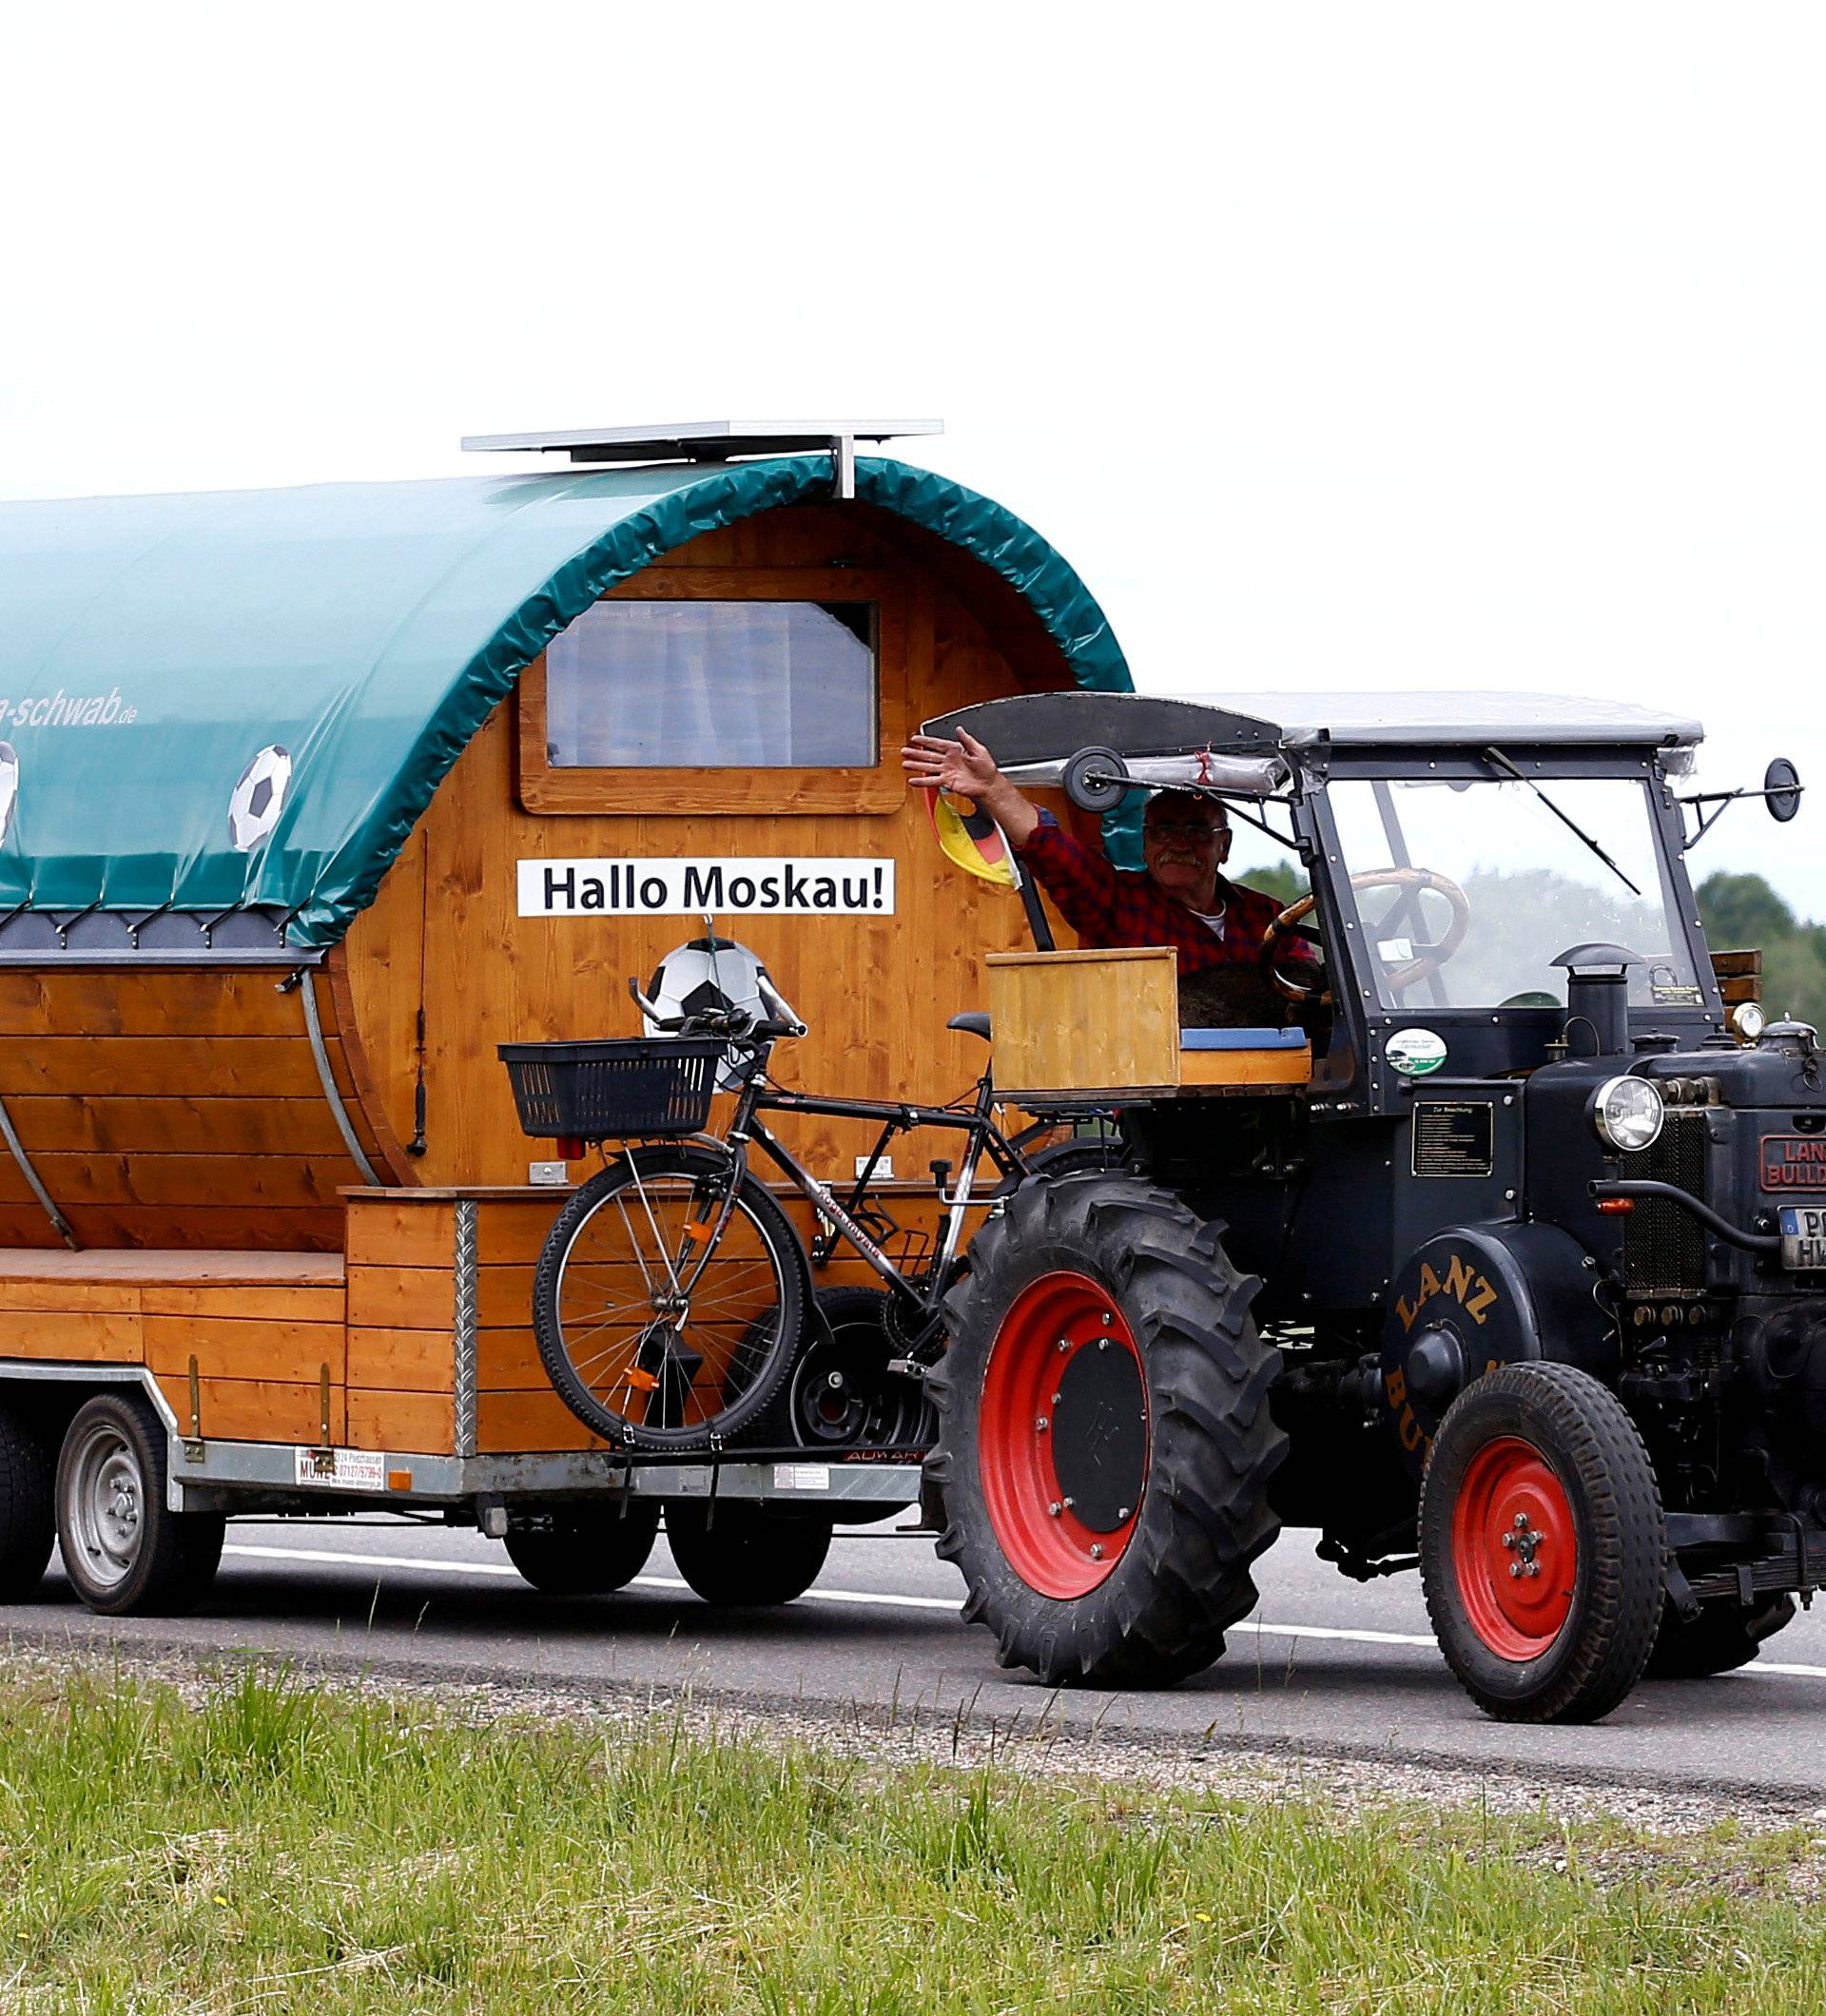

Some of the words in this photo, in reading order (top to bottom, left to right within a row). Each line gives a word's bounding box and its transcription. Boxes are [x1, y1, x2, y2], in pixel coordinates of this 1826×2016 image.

[543, 864, 667, 910] Hallo
[683, 863, 884, 909] Moskau!
[1784, 1142, 1826, 1162] LAN
[1395, 1254, 1498, 1332] LANZ
